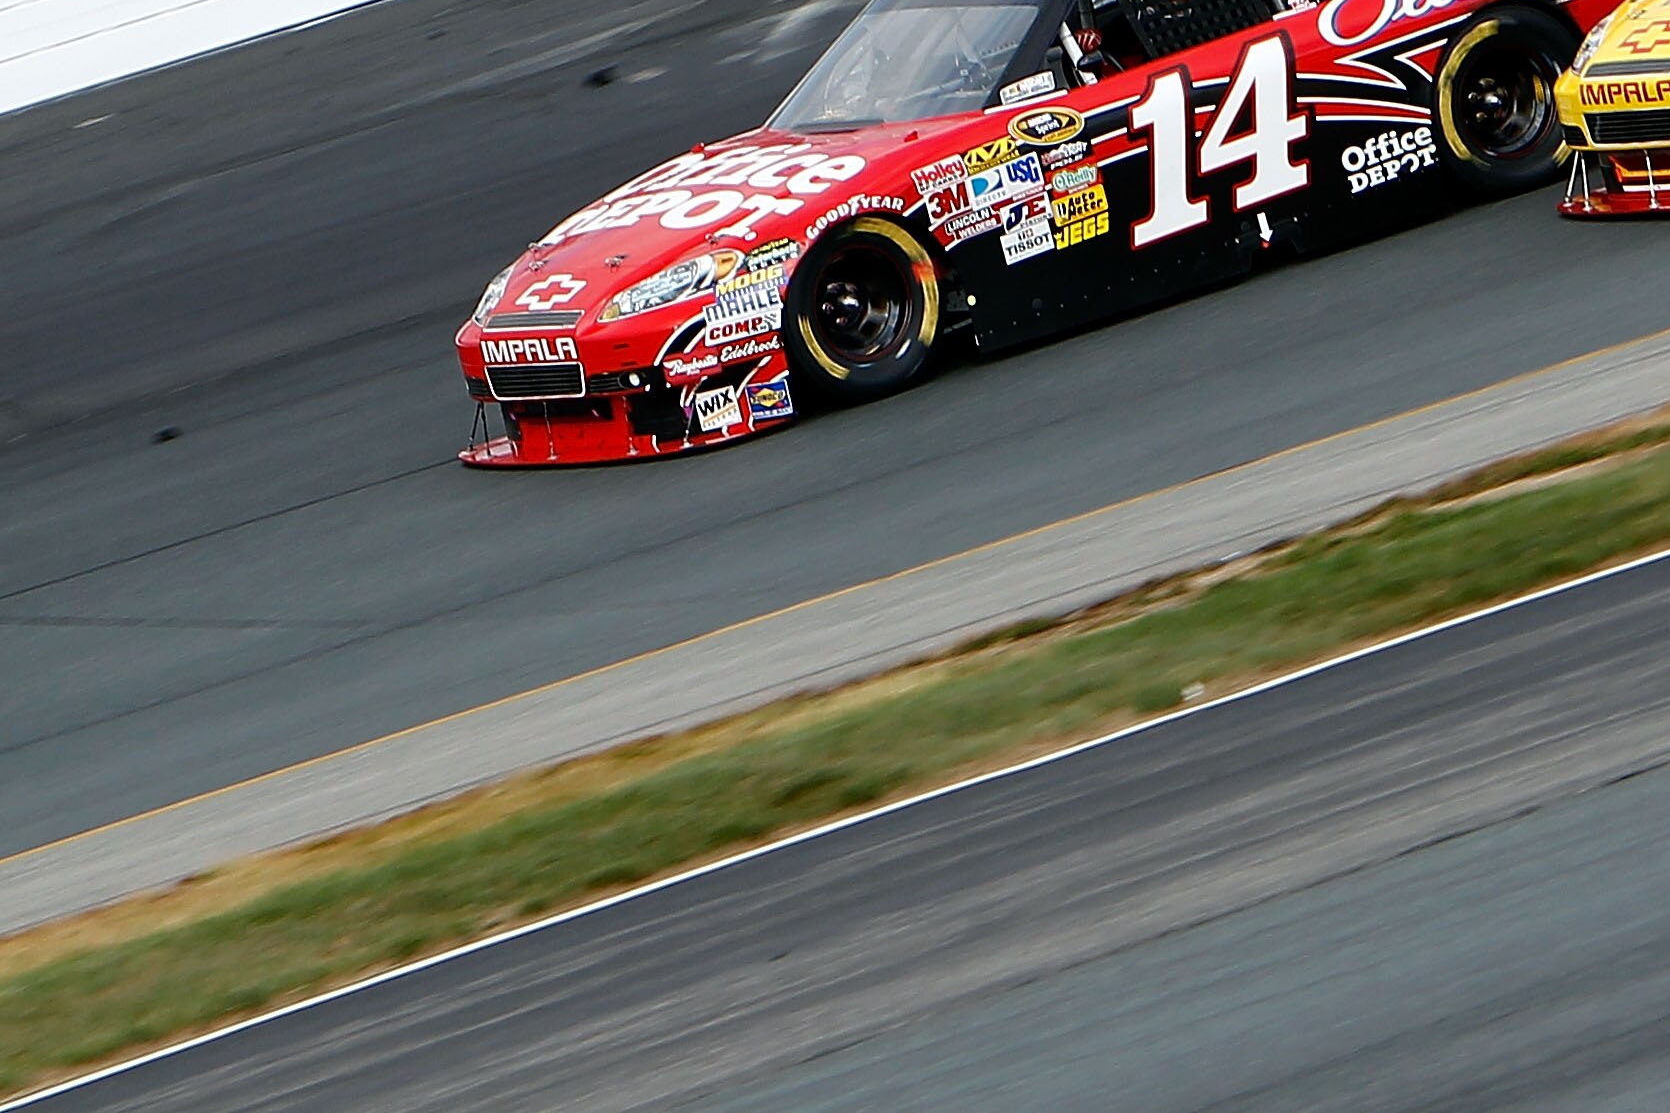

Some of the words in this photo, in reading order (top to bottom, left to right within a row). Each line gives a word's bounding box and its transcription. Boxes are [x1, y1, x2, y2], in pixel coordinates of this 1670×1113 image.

[1131, 34, 1309, 248] 14
[1341, 126, 1433, 172] Office
[604, 143, 868, 203] Office
[914, 159, 966, 187] Holley
[1006, 155, 1041, 183] USG
[1053, 167, 1095, 191] O'Reilly
[1347, 144, 1436, 194] DEPOT
[805, 193, 904, 240] GOODYEAR
[928, 182, 970, 219] 3M
[1006, 195, 1047, 231] JE
[946, 207, 992, 233] LINCOLN
[959, 217, 997, 238] WELDERS
[1054, 212, 1109, 251] JEGS
[1005, 232, 1050, 257] TISSOT
[715, 262, 784, 298] MOOG
[705, 287, 780, 323] MAHLE
[709, 316, 763, 341] COMP
[480, 336, 578, 363] IMPALA
[698, 388, 734, 418] WIX
